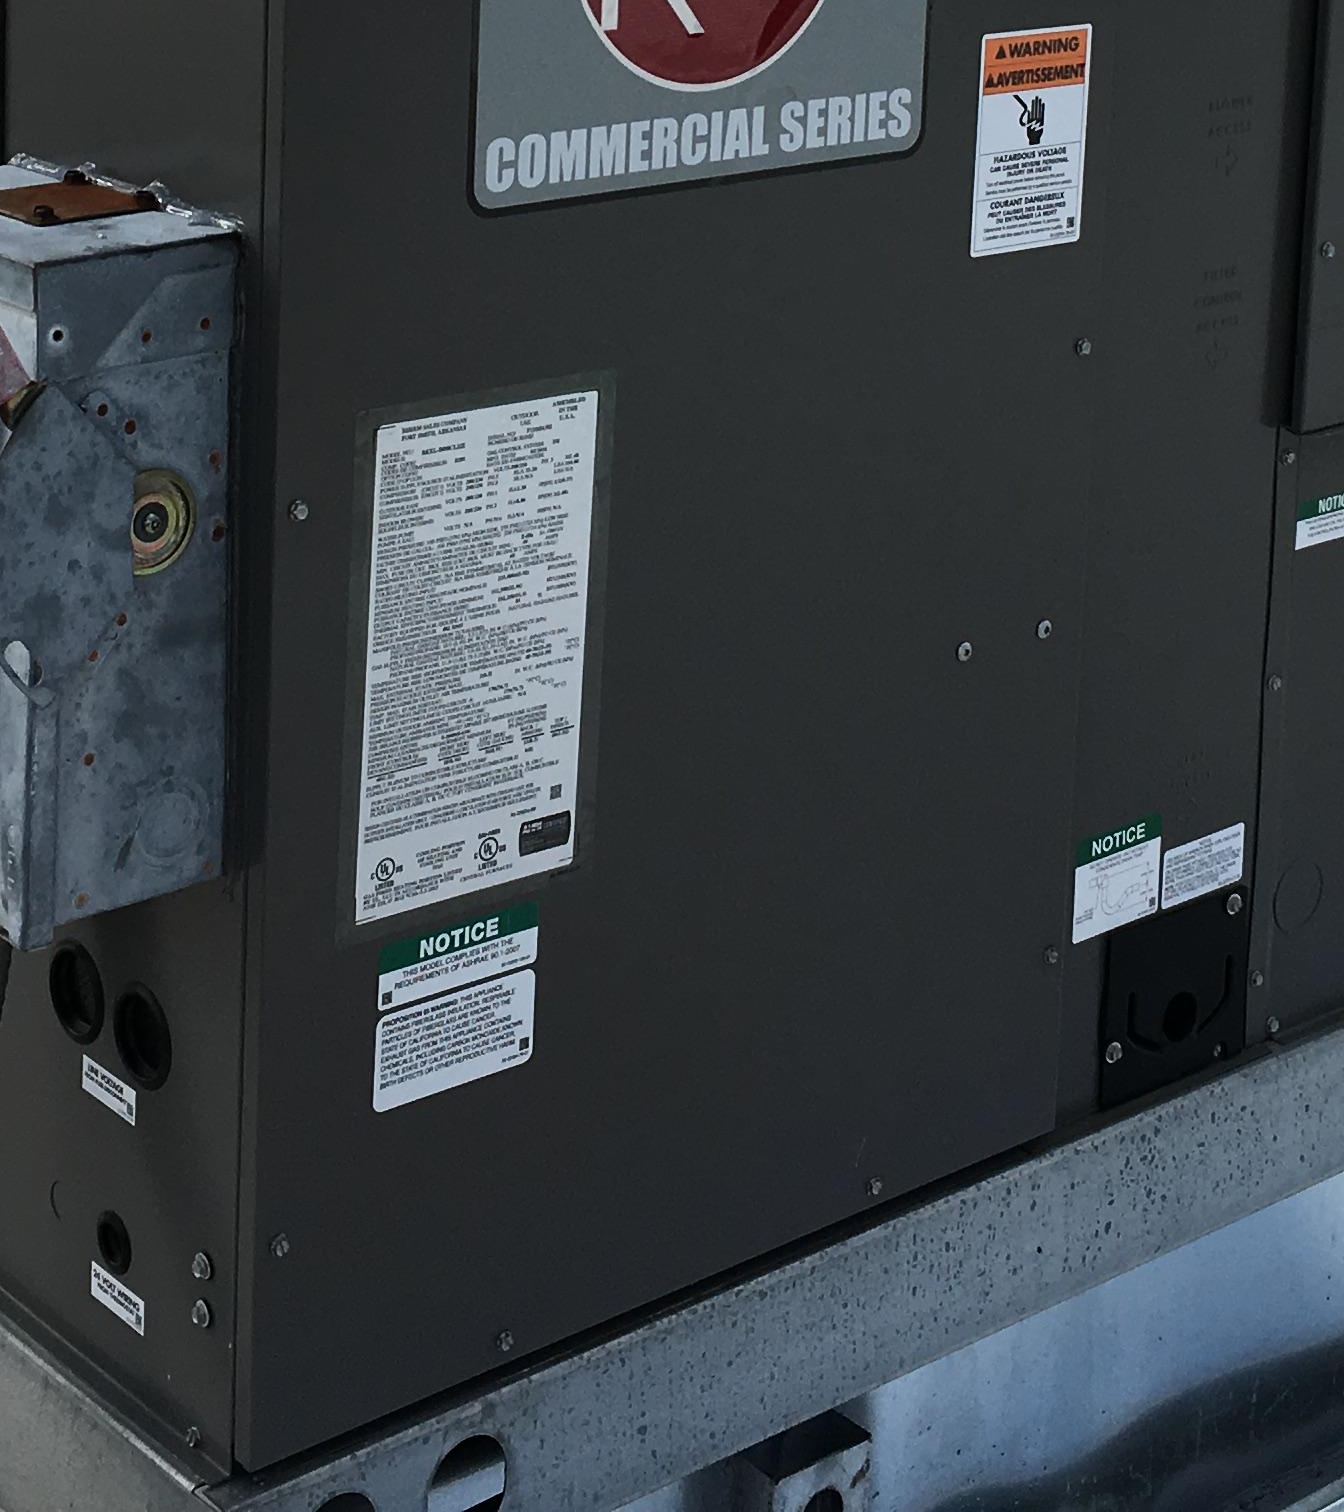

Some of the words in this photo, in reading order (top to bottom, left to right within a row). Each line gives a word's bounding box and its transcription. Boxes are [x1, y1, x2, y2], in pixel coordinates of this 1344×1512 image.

[1009, 36, 1080, 58] WARNING
[995, 63, 1086, 88] AVERTISSEMENT
[485, 106, 768, 193] COMMERCIAL
[780, 87, 912, 153] SERIES
[994, 151, 1035, 164] HAZARDOUS
[1038, 147, 1066, 157] VOLTAGE
[990, 198, 1023, 210] COURANT
[1091, 822, 1146, 857] NOTICE
[419, 916, 499, 958] NOTICE
[394, 966, 449, 990] REQUIREMENTS
[450, 963, 459, 971] OF
[462, 954, 488, 969] ASHRAE
[402, 968, 418, 978] THIS
[420, 960, 443, 973] MODEL
[445, 949, 480, 964] COMPLIES
[482, 942, 499, 953] WITH
[501, 937, 514, 947] THE
[382, 1010, 422, 1028] PROPOSITION
[474, 984, 503, 998] APPLIANCE
[382, 1023, 410, 1037] CONTAINS
[411, 1011, 446, 1028] FIBERGLASS
[482, 988, 516, 1004] RESPIRABLE
[382, 1031, 412, 1046] PARTICLES
[470, 1005, 492, 1017] KNOWN
[493, 1001, 500, 1009] TO
[501, 997, 511, 1006] THE
[381, 1045, 398, 1055] STATE
[409, 1030, 442, 1046] CALIFORNIA
[452, 1020, 470, 1031] CAUSE
[381, 1051, 407, 1063] EXHAUST
[408, 1047, 420, 1055] GAS
[421, 1038, 437, 1050] FROM
[452, 1025, 482, 1041] APPLIANCE
[484, 1014, 511, 1029] CONTAINS
[416, 1046, 447, 1060] INCLUDING
[472, 1029, 501, 1042] MONOXIDE
[380, 1073, 388, 1081] TO
[401, 1064, 418, 1074] STATE
[429, 1049, 462, 1064] CALIFORNIA
[463, 1045, 470, 1053] TO
[472, 1038, 490, 1050] CAUSE
[398, 1072, 424, 1084] DEFECTS
[435, 1059, 454, 1071] OTHER
[455, 1045, 497, 1065] REPRODUCTIVE
[94, 1269, 100, 1280] 24
[102, 1275, 116, 1292] VOLT
[117, 1288, 140, 1312] WIRING
